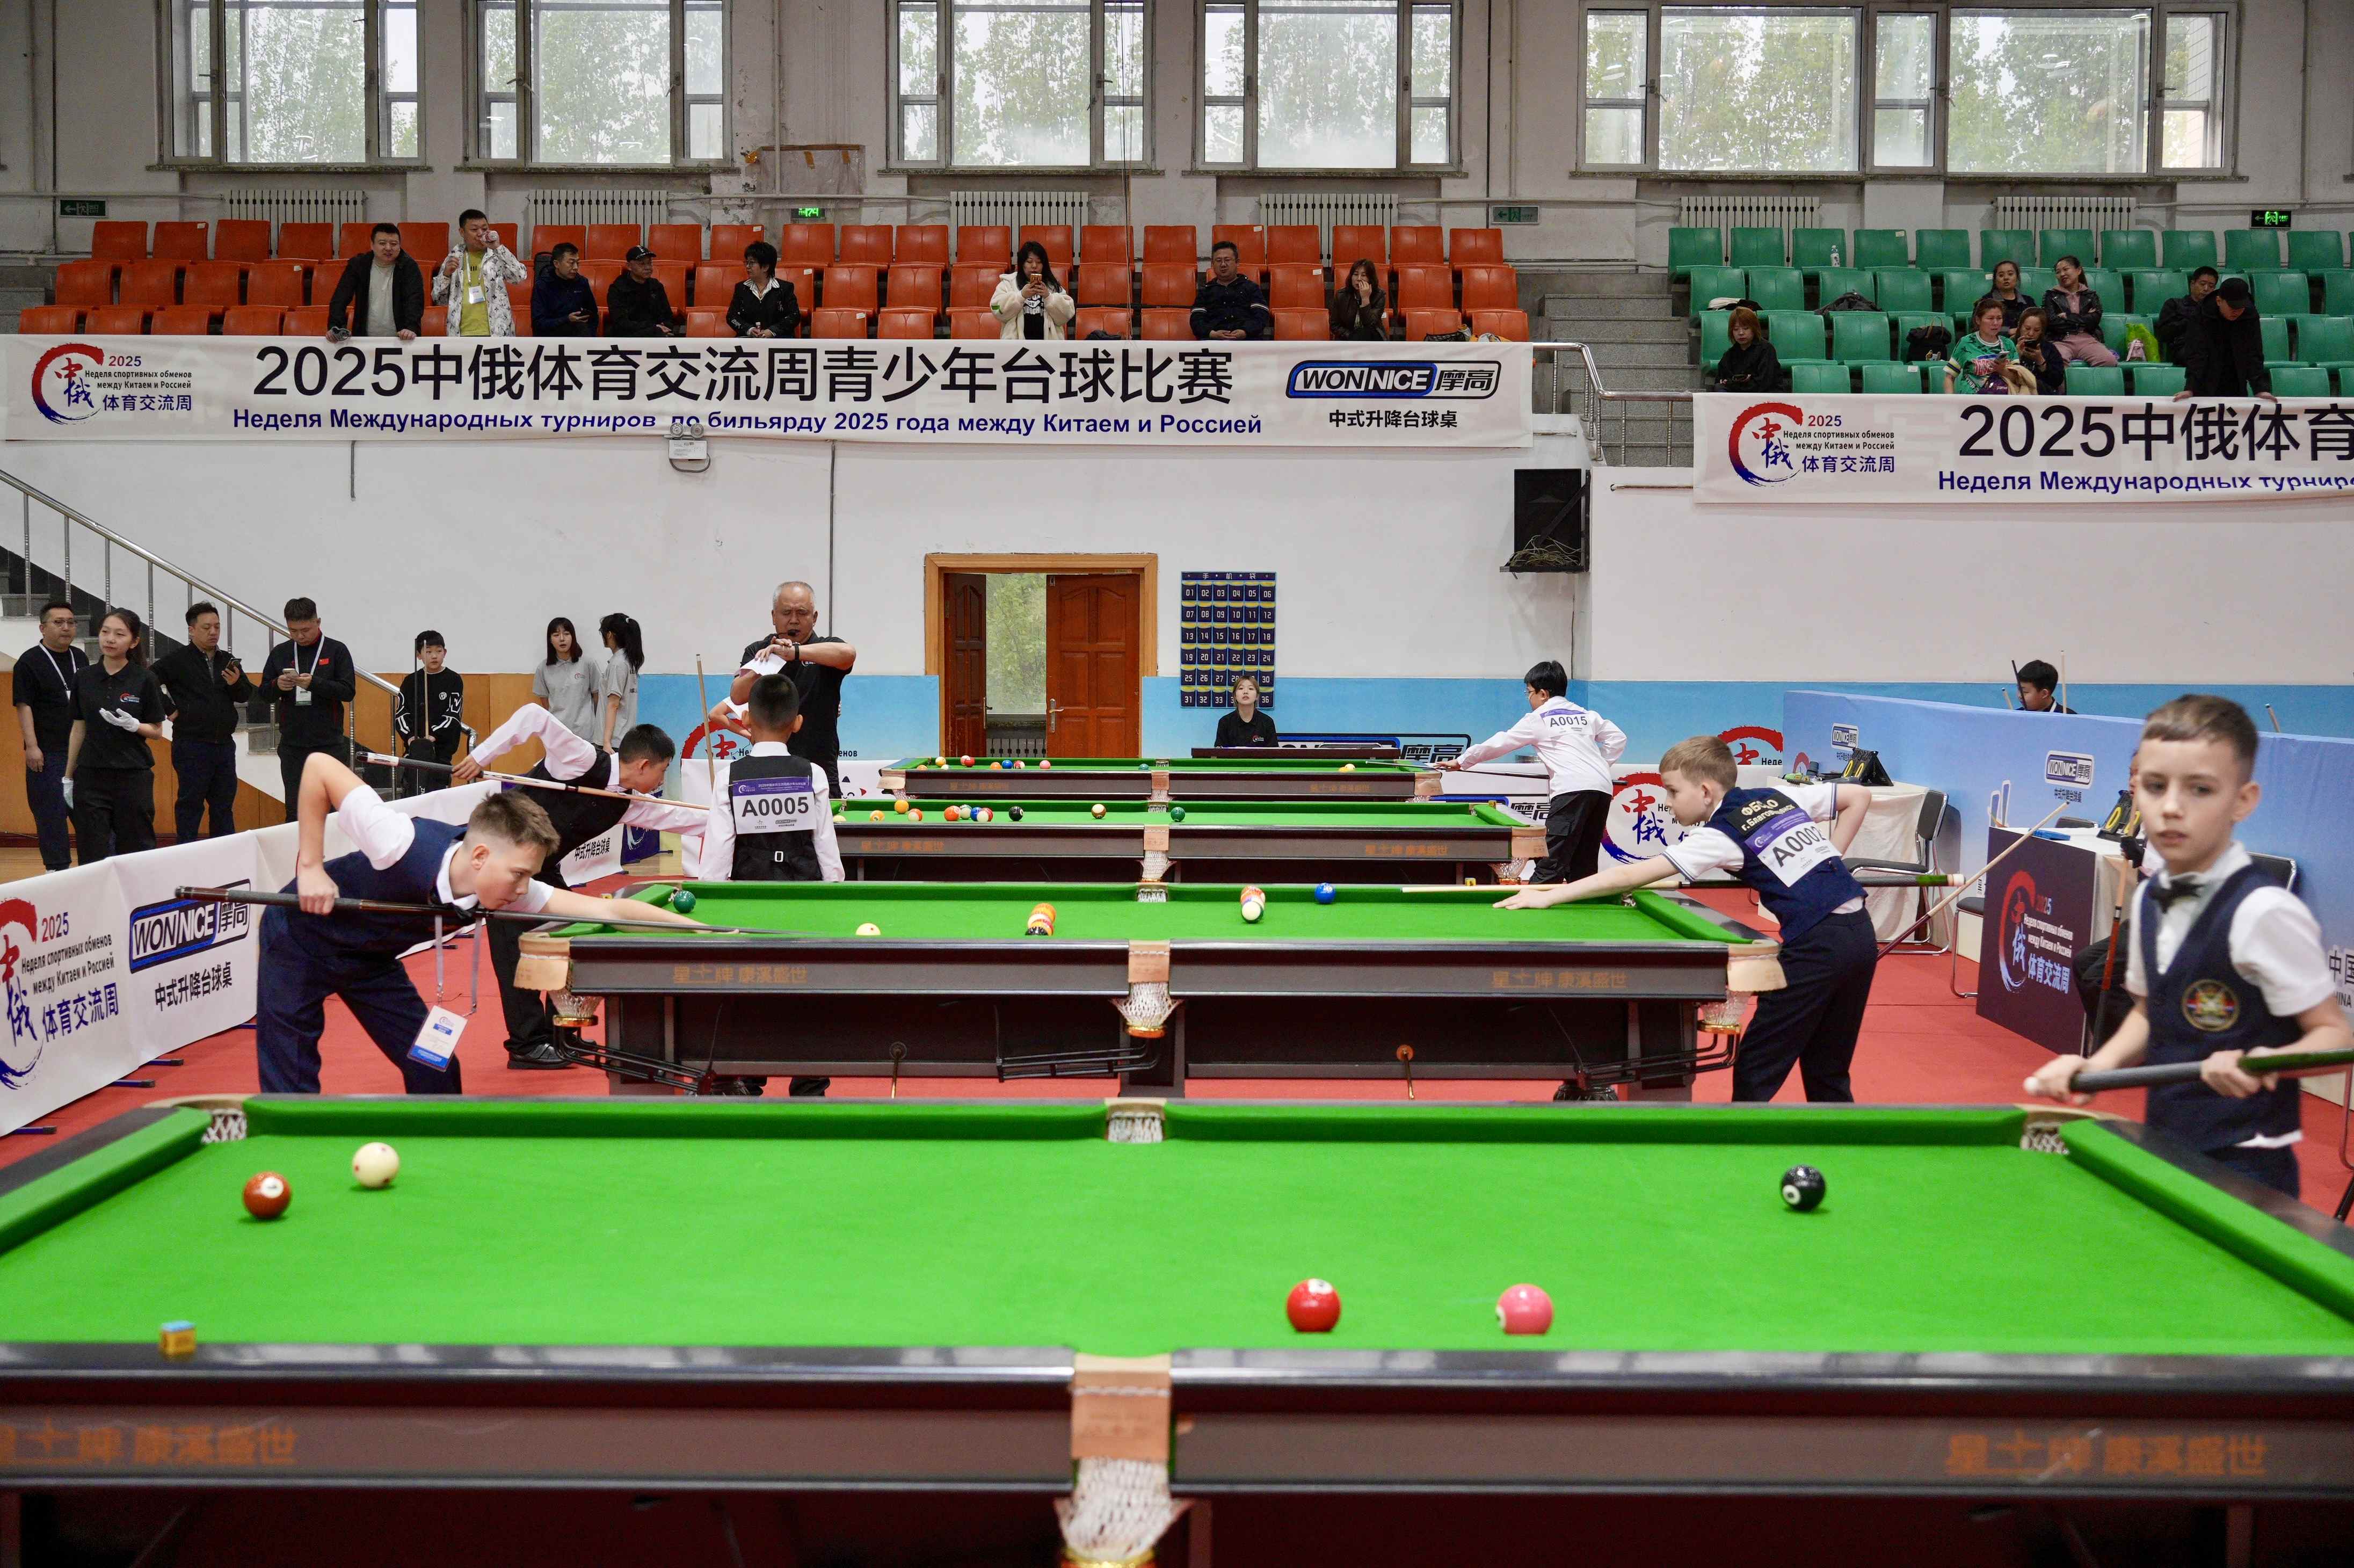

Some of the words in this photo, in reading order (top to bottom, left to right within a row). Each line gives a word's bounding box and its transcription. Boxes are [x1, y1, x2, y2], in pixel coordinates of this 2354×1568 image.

[108, 356, 141, 366] 2025
[85, 371, 112, 379] Неделя
[253, 344, 1233, 404] 2025中俄体育交流周青少年台球比赛
[1303, 369, 1430, 390] WONNICE
[1434, 371, 1494, 391] 摩高
[103, 394, 191, 411] 体育交流周
[234, 409, 321, 431] Неделя
[331, 409, 533, 432] Международных
[541, 416, 656, 431] турниров
[708, 411, 826, 433] бильярду
[834, 413, 888, 430] 2025
[897, 418, 949, 433] года
[958, 418, 1035, 436] между
[1044, 414, 1129, 432] Китаем
[1139, 419, 1151, 432] и
[1161, 415, 1260, 433] Россией
[1329, 410, 1457, 427] 中式升降台球桌
[1808, 416, 1841, 426] 2025
[1784, 431, 1811, 439] Неделя
[1862, 430, 1894, 438] обменов
[1802, 455, 1894, 473] 体育交流周
[1939, 471, 2031, 493] Неделя
[2040, 471, 2251, 494] Международных
[1550, 716, 1587, 727] A0015
[742, 797, 809, 817] A0005
[1772, 826, 1826, 868] A0002
[41, 912, 69, 942] 2025
[134, 903, 215, 955] WONNICE
[21, 955, 46, 975] Неделя
[47, 942, 84, 967] спортивных
[84, 934, 112, 953] обменов
[33, 975, 55, 994] между
[56, 966, 81, 986] Китаем
[82, 964, 87, 976] и
[87, 952, 115, 976] Россией
[155, 961, 233, 1012] 中式升降台球桌
[42, 982, 119, 1042] 体育交流周
